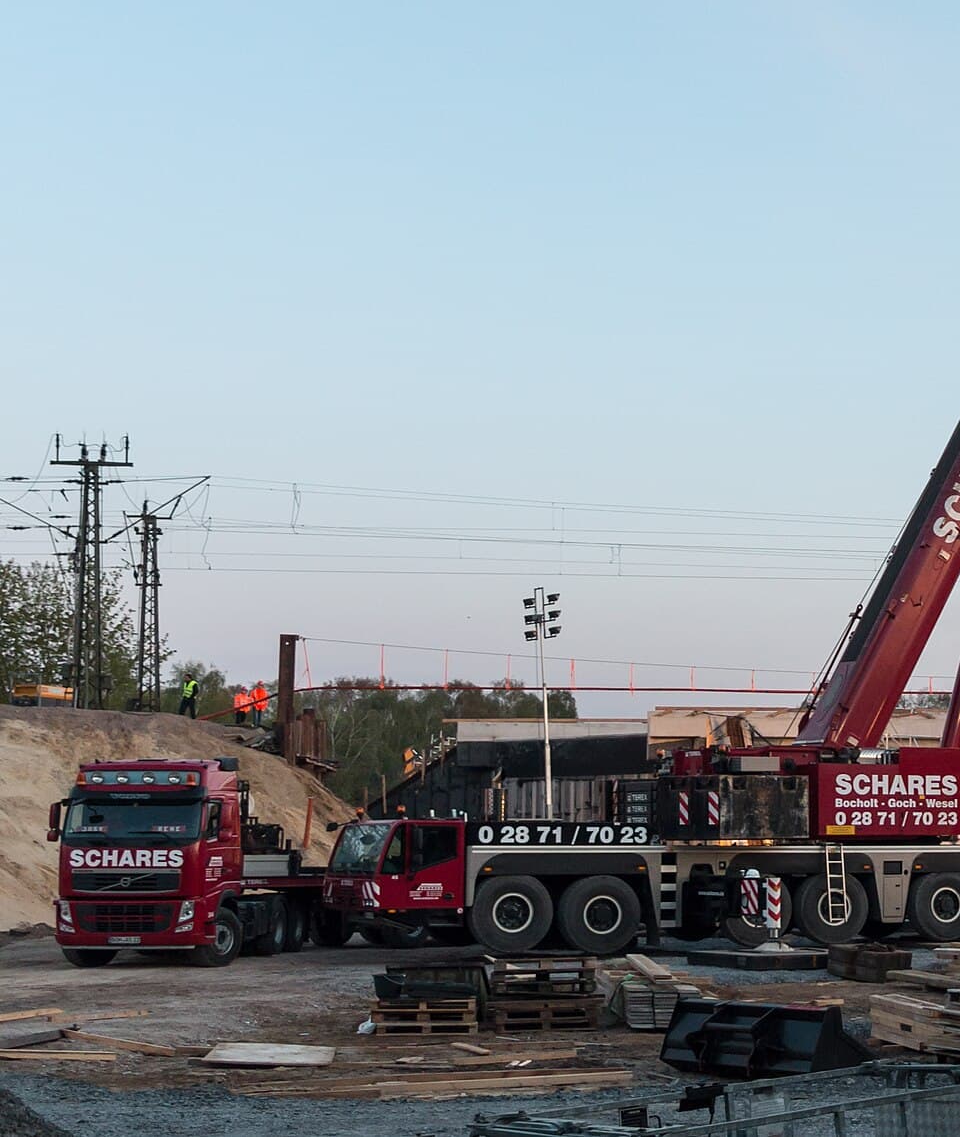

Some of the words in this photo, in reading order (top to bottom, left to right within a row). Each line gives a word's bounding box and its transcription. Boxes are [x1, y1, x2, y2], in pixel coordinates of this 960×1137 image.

[835, 773, 958, 796] SCHARES
[835, 798, 879, 808] Bocholt
[887, 798, 917, 808] Goch
[925, 798, 958, 808] Wesel
[835, 811, 847, 826] 0
[850, 811, 873, 826] 28
[877, 811, 897, 826] 71
[901, 811, 909, 827] /
[912, 811, 934, 826] 70
[937, 811, 958, 826] 23
[478, 825, 494, 844] 0
[500, 825, 530, 844] 28
[536, 825, 562, 844] 71
[571, 825, 580, 846] /
[586, 825, 615, 844] 70
[619, 825, 648, 844] 23
[69, 849, 184, 868] SCHARES
